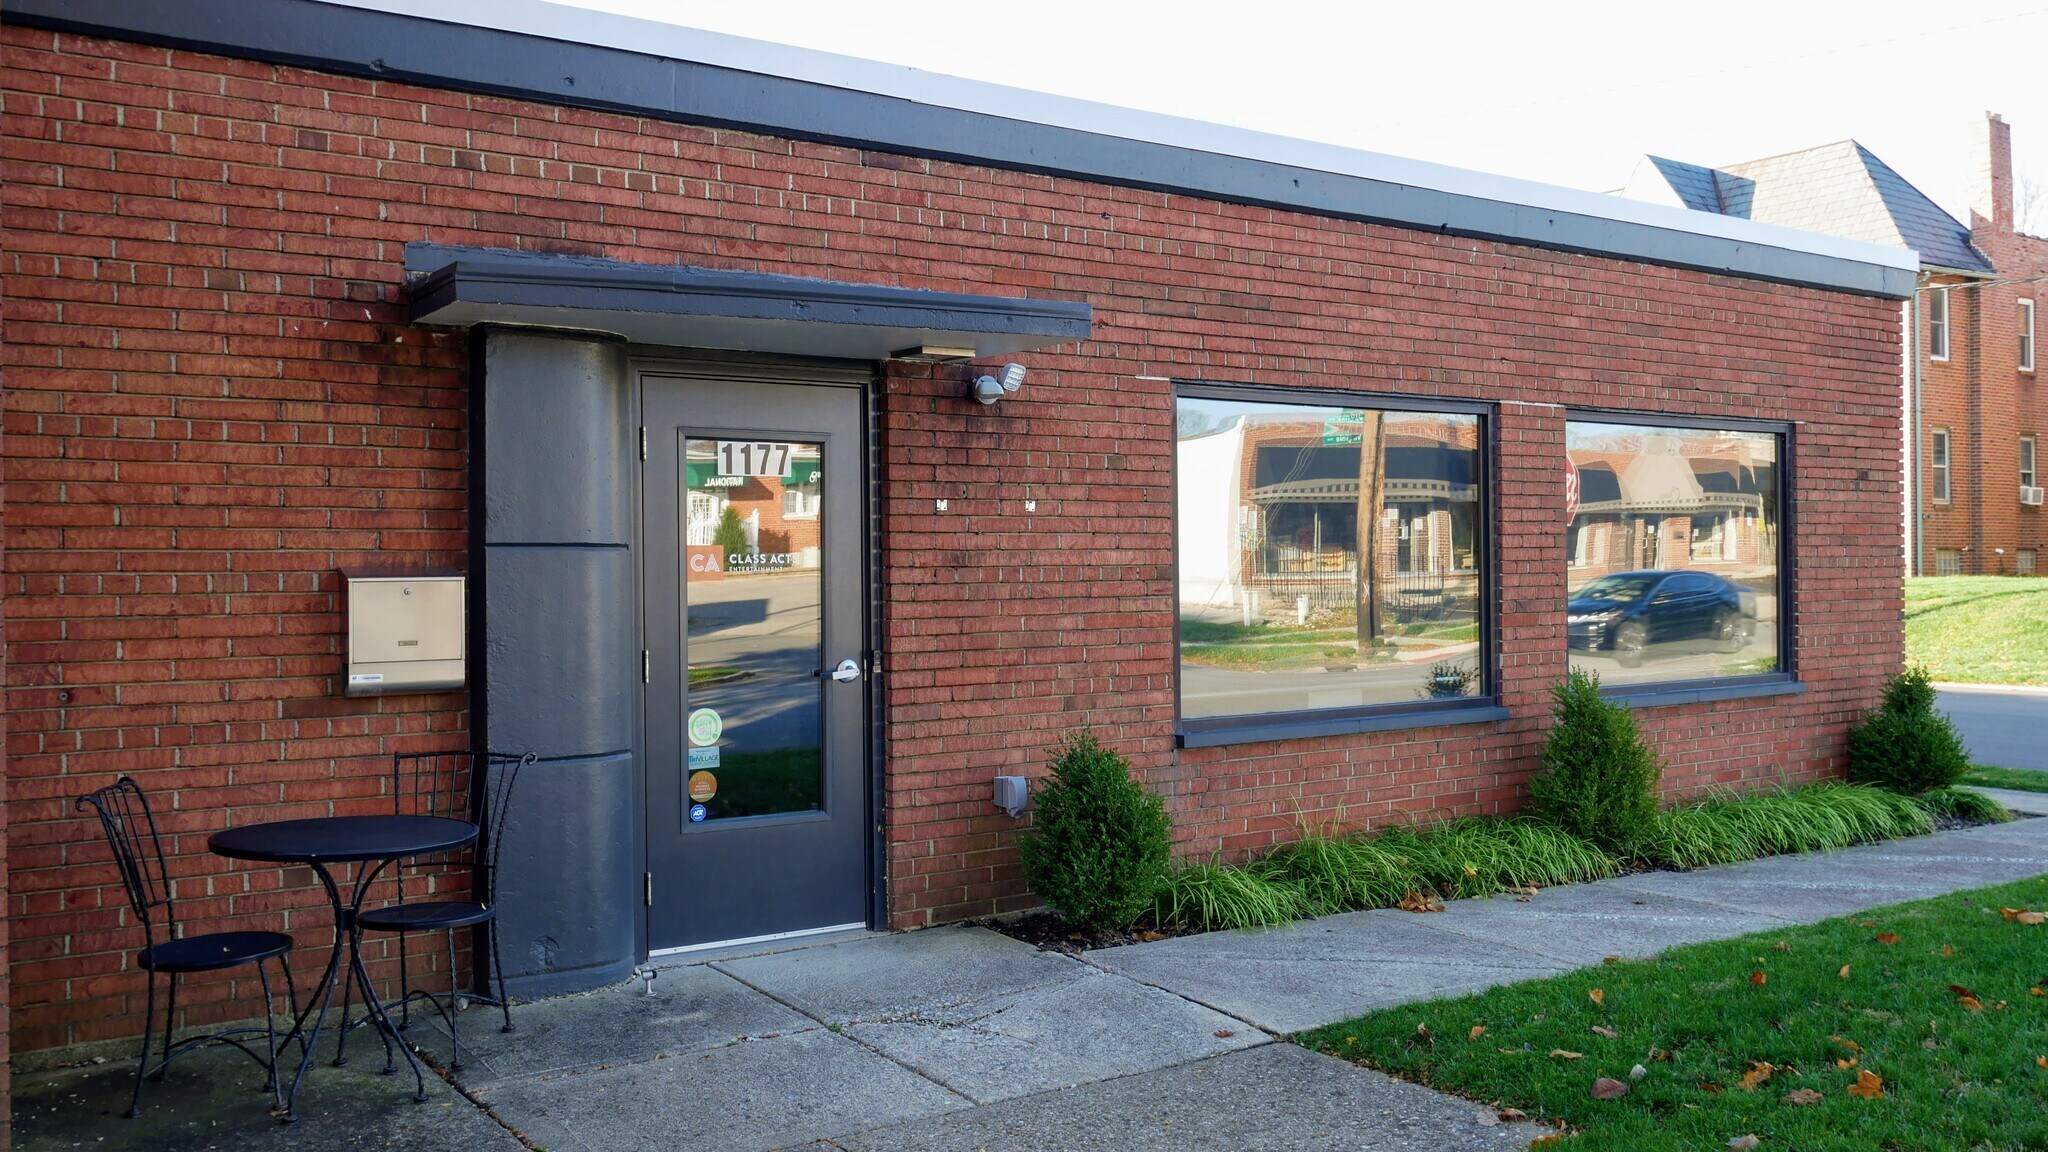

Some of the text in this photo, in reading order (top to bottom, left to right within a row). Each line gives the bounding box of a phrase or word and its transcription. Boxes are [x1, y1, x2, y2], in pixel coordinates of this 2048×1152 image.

[721, 443, 789, 476] 1177
[690, 553, 720, 573] CA
[729, 553, 767, 564] CLASS
